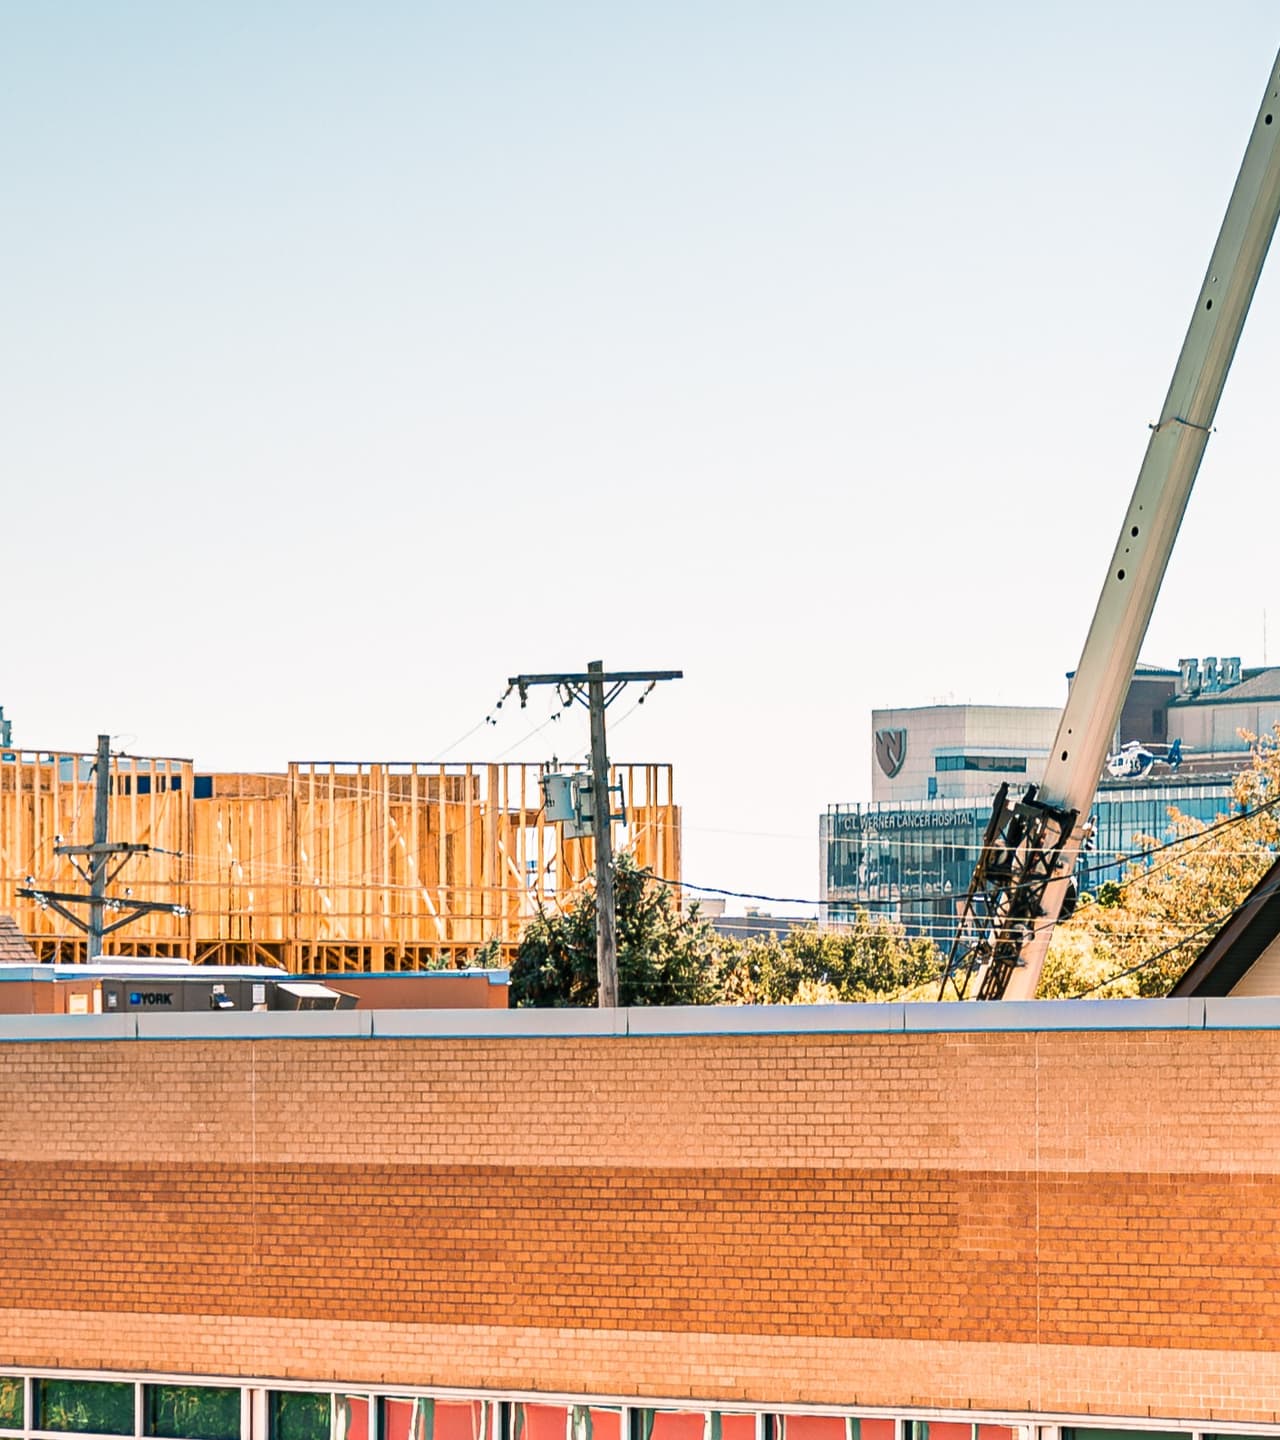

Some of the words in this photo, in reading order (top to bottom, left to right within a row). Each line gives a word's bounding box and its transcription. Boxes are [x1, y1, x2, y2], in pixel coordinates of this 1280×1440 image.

[860, 814, 895, 831] WERNER
[897, 812, 931, 828] CANCER
[931, 810, 973, 827] HOSPITAL
[141, 992, 173, 1004] YORK
